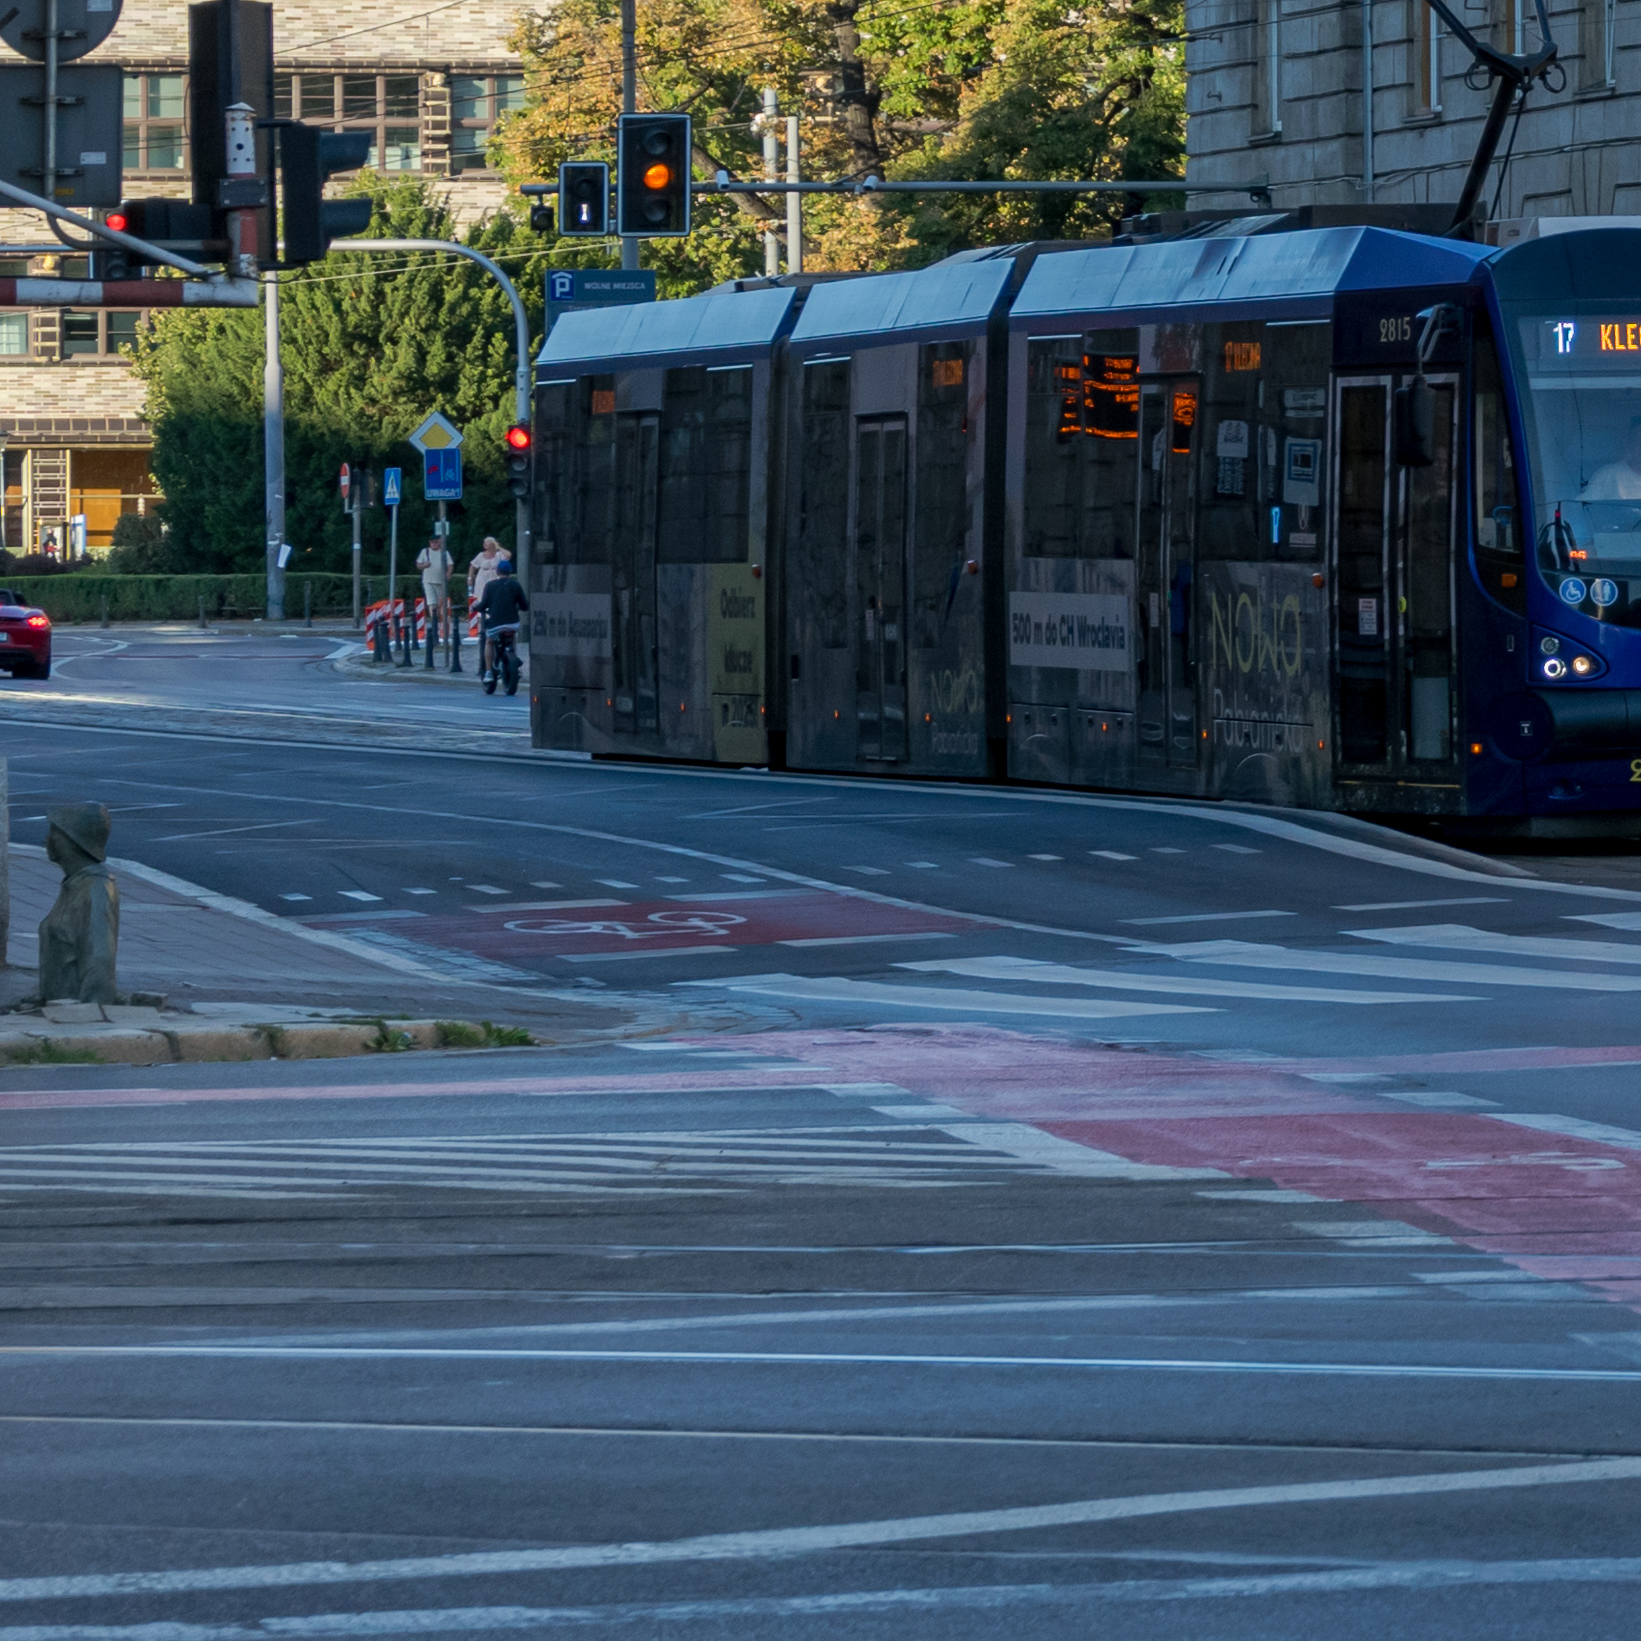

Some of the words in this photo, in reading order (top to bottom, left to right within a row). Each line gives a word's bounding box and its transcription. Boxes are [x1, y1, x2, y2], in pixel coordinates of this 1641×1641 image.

[584, 282, 611, 290] WOLNE
[613, 282, 646, 290] MIEJSCA
[1380, 316, 1411, 343] 2815
[1553, 321, 1576, 353] 17
[721, 586, 756, 619] Odbierz
[1012, 612, 1031, 645] 500
[1033, 621, 1043, 645] m
[1045, 614, 1058, 646] do
[1059, 614, 1075, 647] CH
[1077, 615, 1125, 649] Wroclavia
